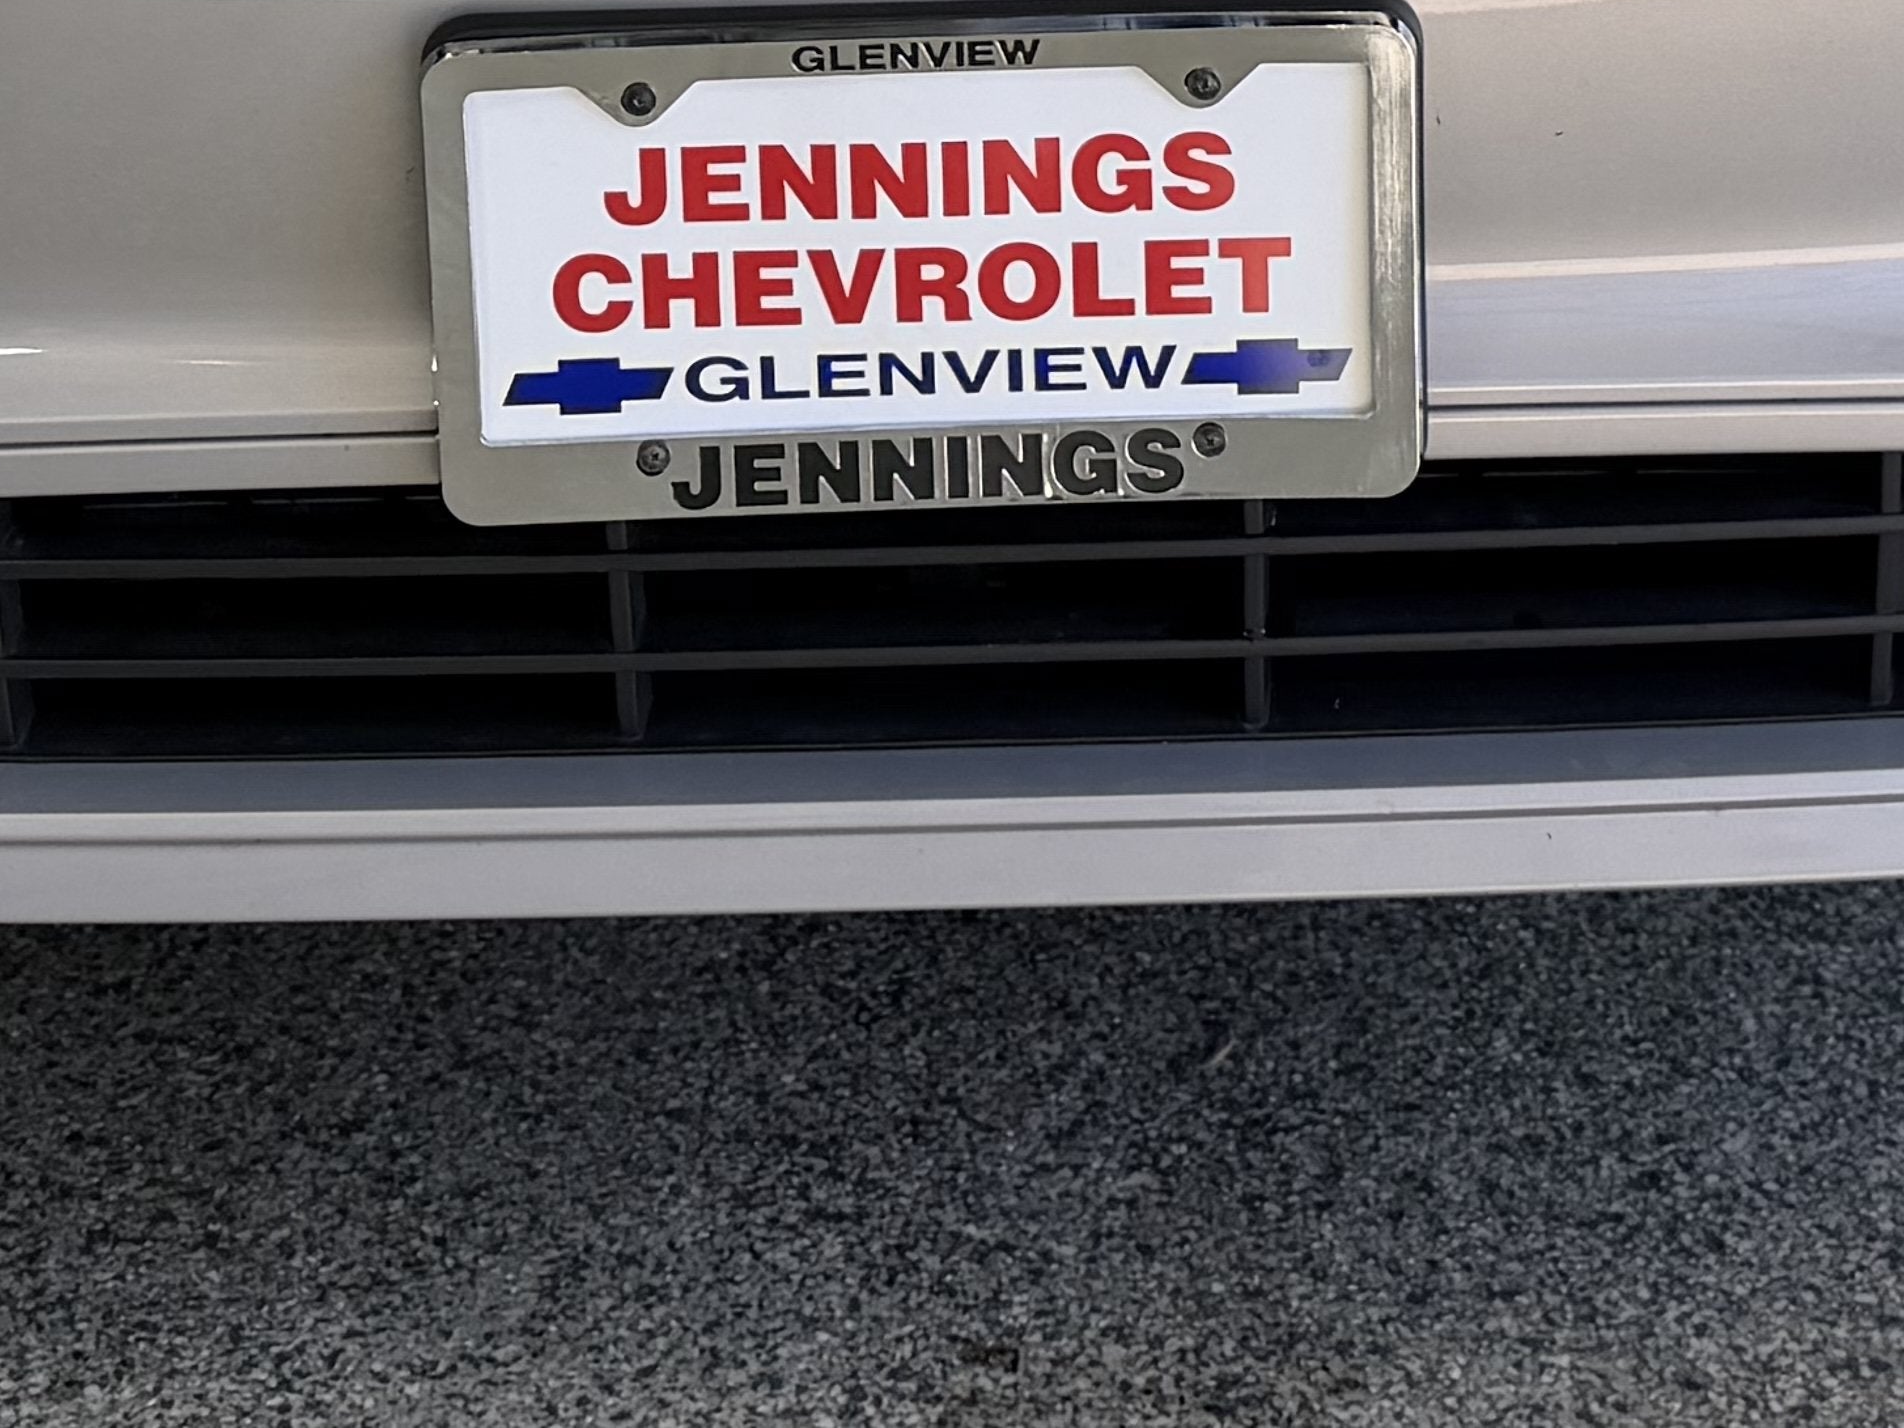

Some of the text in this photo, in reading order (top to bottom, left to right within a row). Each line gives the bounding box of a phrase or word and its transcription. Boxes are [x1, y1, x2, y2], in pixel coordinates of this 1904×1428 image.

[790, 38, 1041, 74] GLENVIEW
[603, 130, 1236, 227] JENNINGS
[552, 236, 1293, 333] CHEVROLET
[685, 344, 1178, 401] GLENVIEW
[671, 428, 1185, 510] JENNINGS
